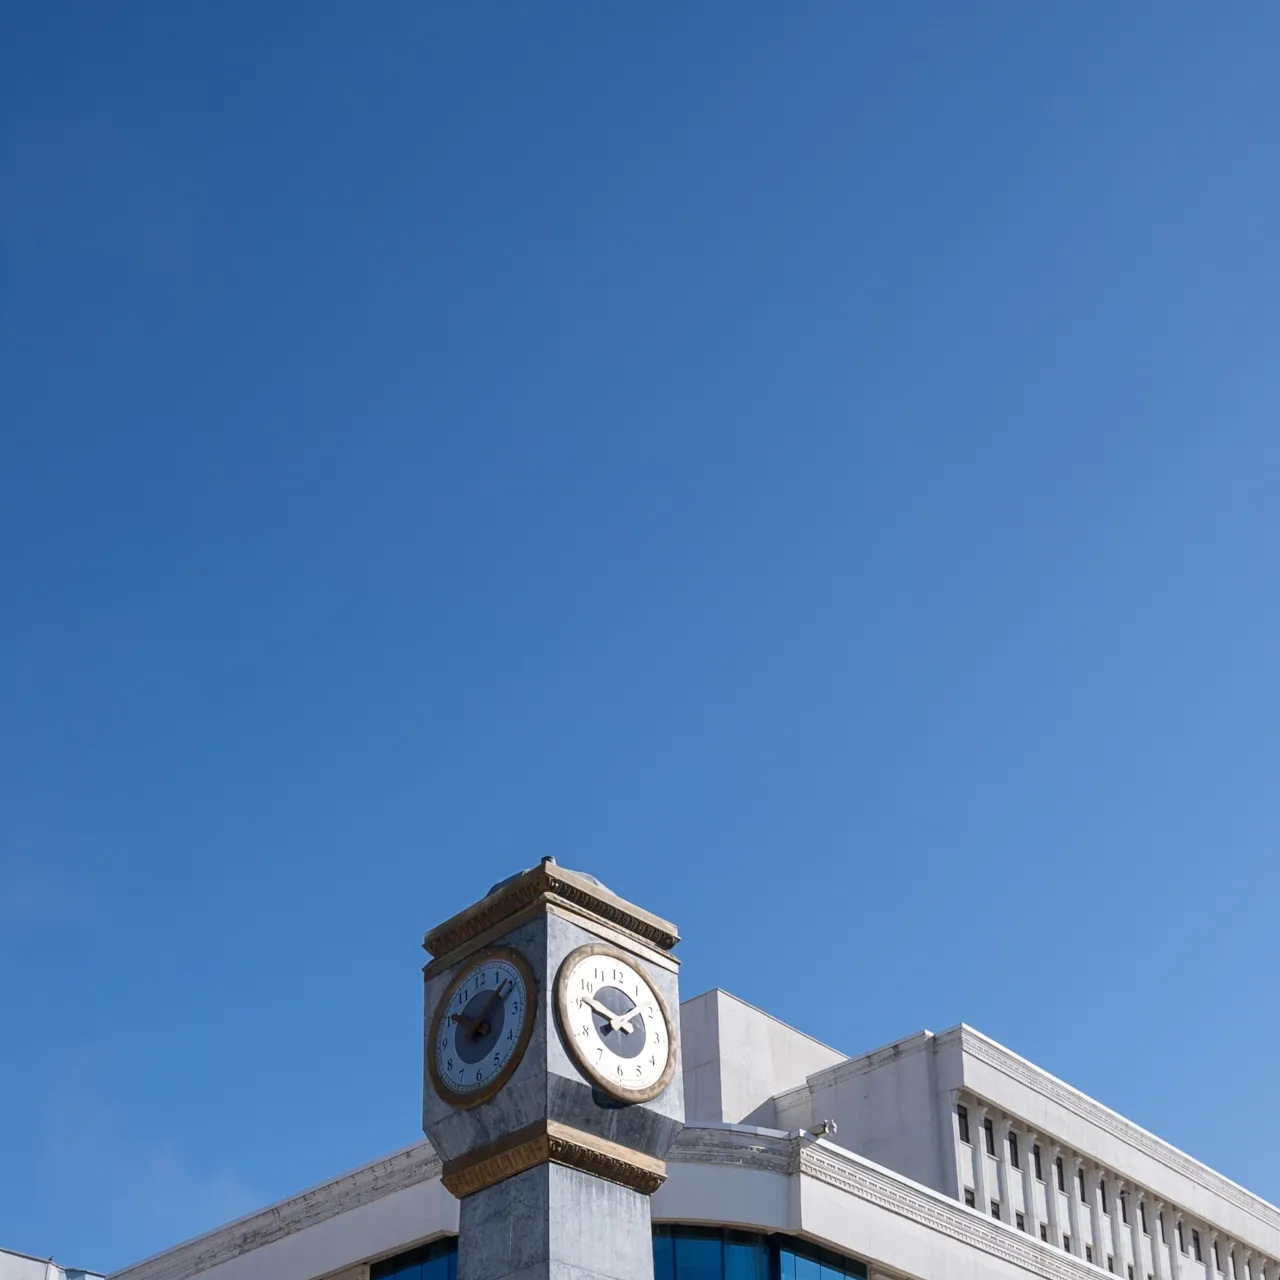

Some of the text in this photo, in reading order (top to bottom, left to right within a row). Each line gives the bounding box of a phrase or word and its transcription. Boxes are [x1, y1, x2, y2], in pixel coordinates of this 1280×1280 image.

[475, 973, 486, 989] 12
[495, 972, 499, 984] 1
[594, 968, 605, 982] 11
[612, 969, 624, 984] 12
[581, 979, 593, 993] 10
[635, 985, 639, 997] 1
[458, 990, 468, 1004] 11
[576, 997, 583, 1009] 9
[512, 1002, 518, 1015] 3
[648, 1006, 654, 1018] 2
[507, 1029, 513, 1041] 4
[582, 1025, 589, 1038] 8
[442, 1038, 448, 1051] 9
[653, 1032, 660, 1045] 3
[494, 1052, 500, 1066] 5
[596, 1048, 603, 1065] 7
[649, 1055, 655, 1066] 4
[447, 1059, 453, 1071] 8
[617, 1065, 624, 1077] 6
[635, 1065, 642, 1077] 5
[458, 1070, 464, 1082] 7
[476, 1069, 483, 1081] 6
